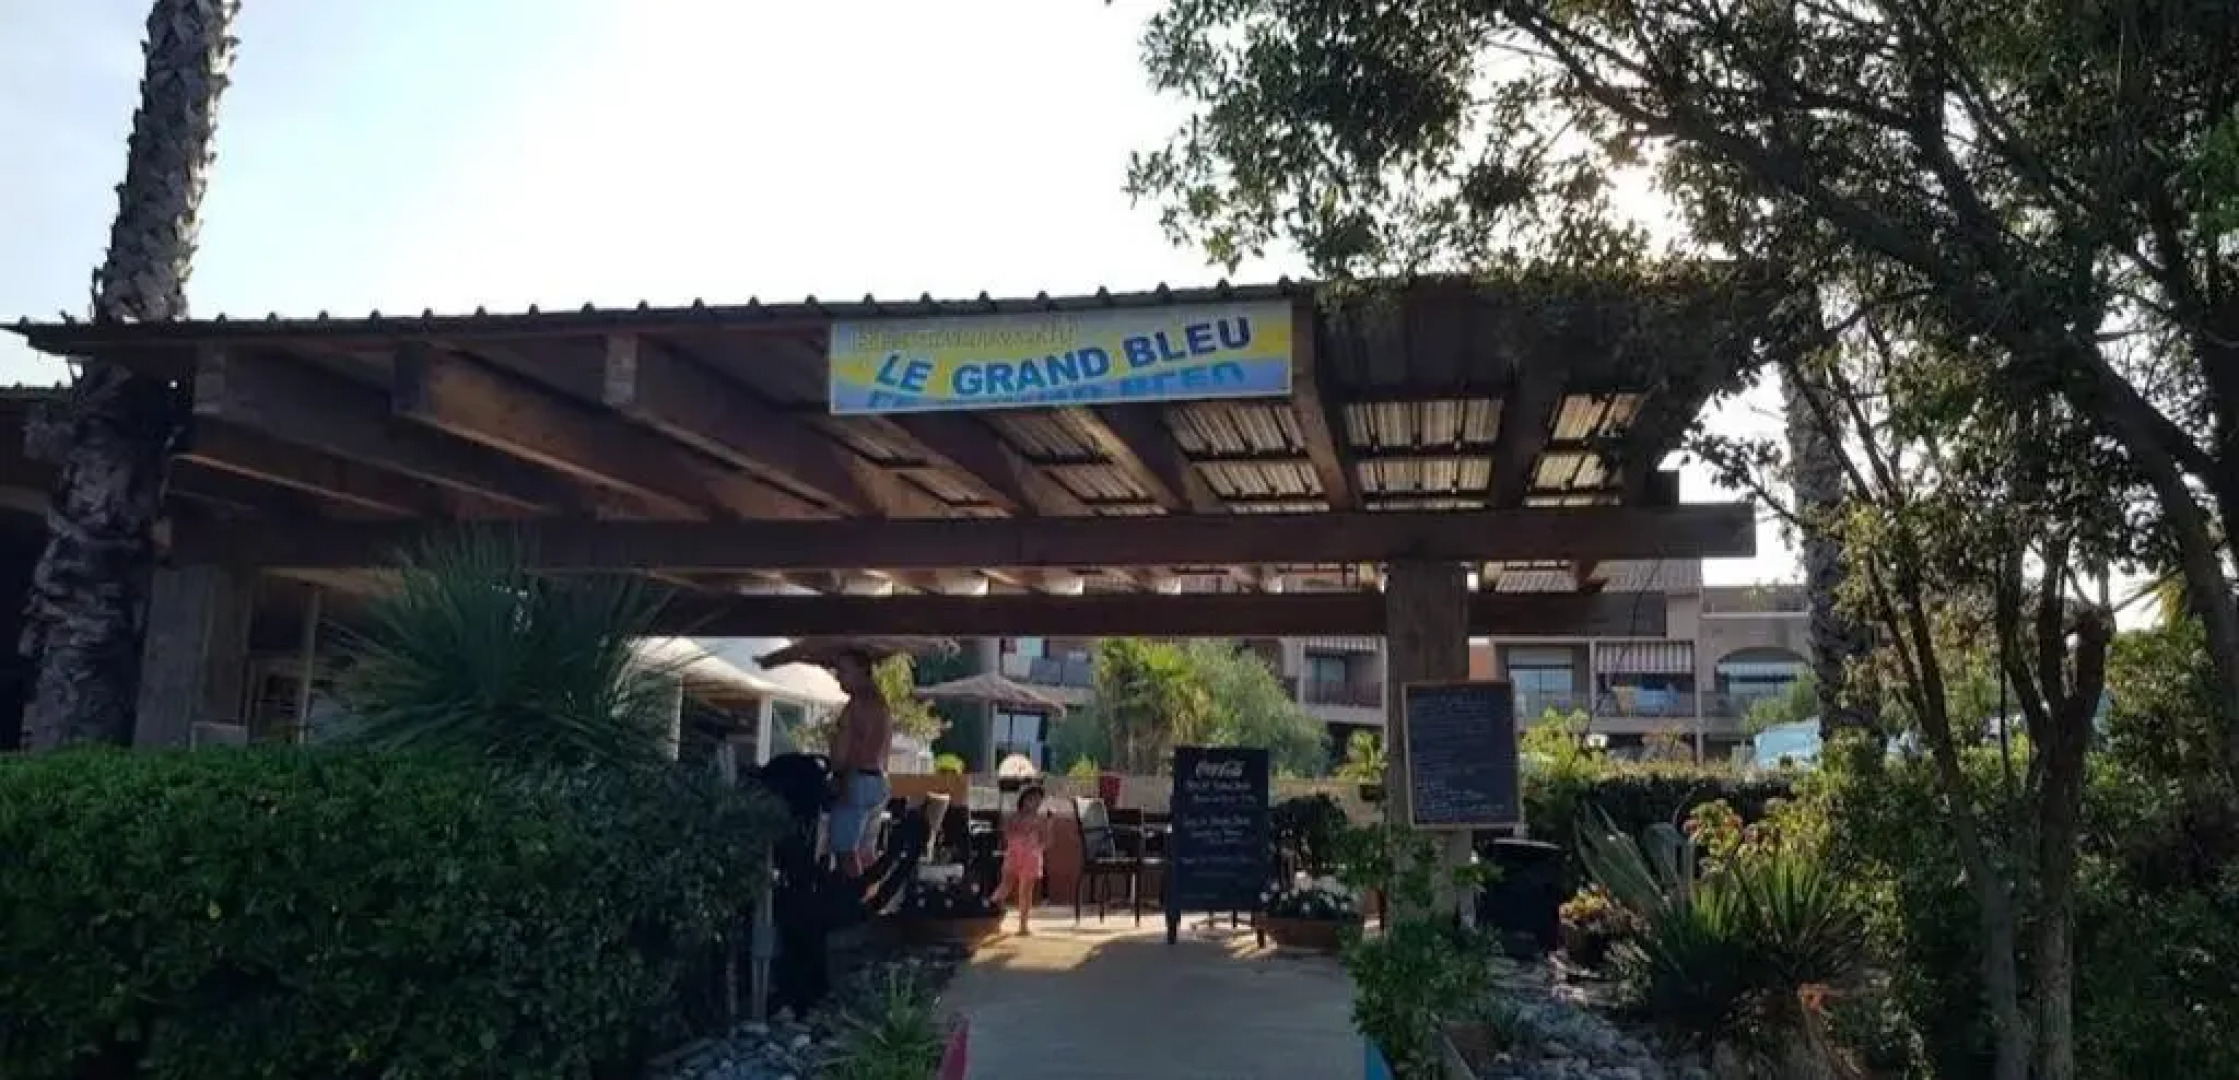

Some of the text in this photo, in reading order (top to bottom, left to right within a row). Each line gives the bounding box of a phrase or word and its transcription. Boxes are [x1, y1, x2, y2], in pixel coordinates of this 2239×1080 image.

[877, 351, 932, 392] LE
[952, 347, 1109, 395] GRAND
[1123, 317, 1251, 368] BLEU
